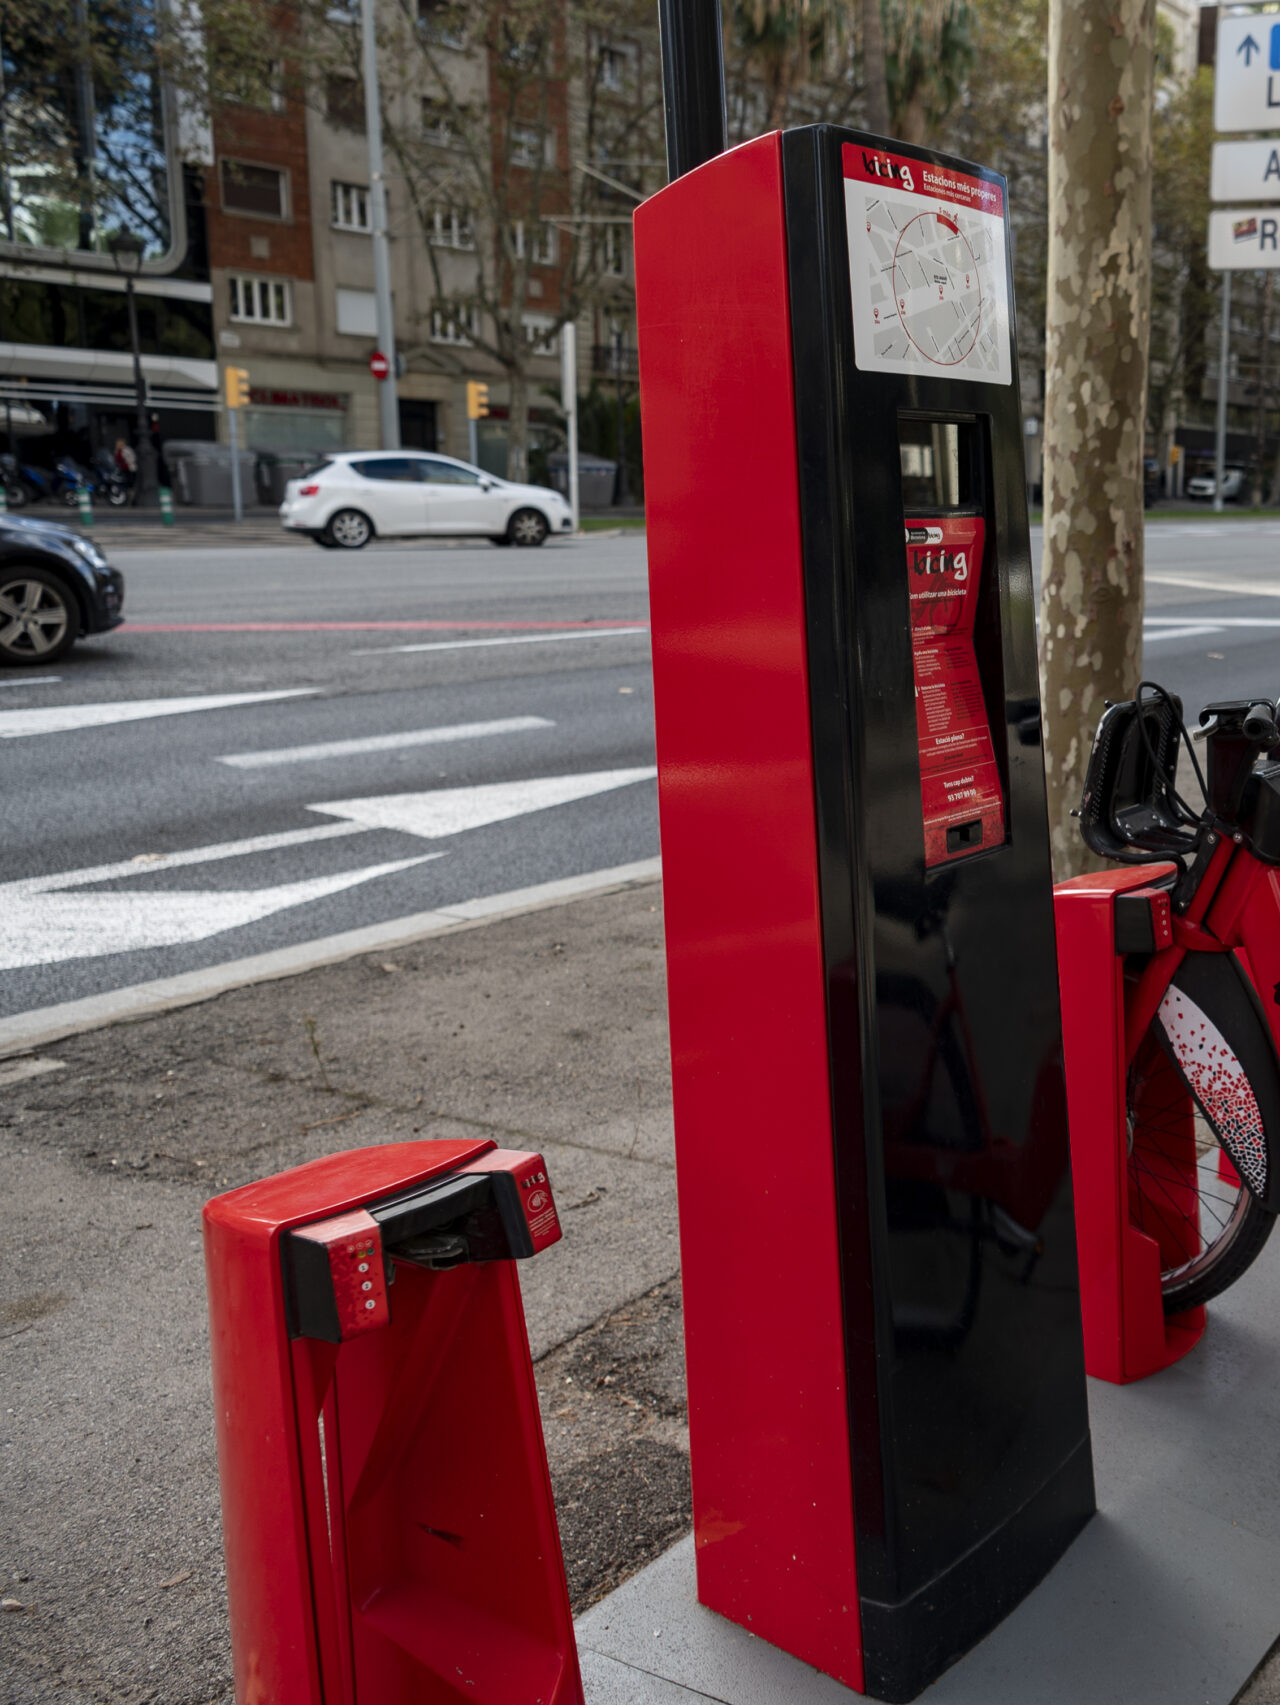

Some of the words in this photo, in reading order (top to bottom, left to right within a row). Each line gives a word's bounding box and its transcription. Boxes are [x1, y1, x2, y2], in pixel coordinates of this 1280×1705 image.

[862, 152, 915, 191] bicing
[922, 170, 956, 189] Estacions
[956, 182, 970, 193] més
[970, 187, 997, 202] properes
[914, 549, 968, 580] bicing
[909, 592, 918, 600] om
[947, 588, 967, 596] bicicleta
[935, 735, 951, 745] Estació
